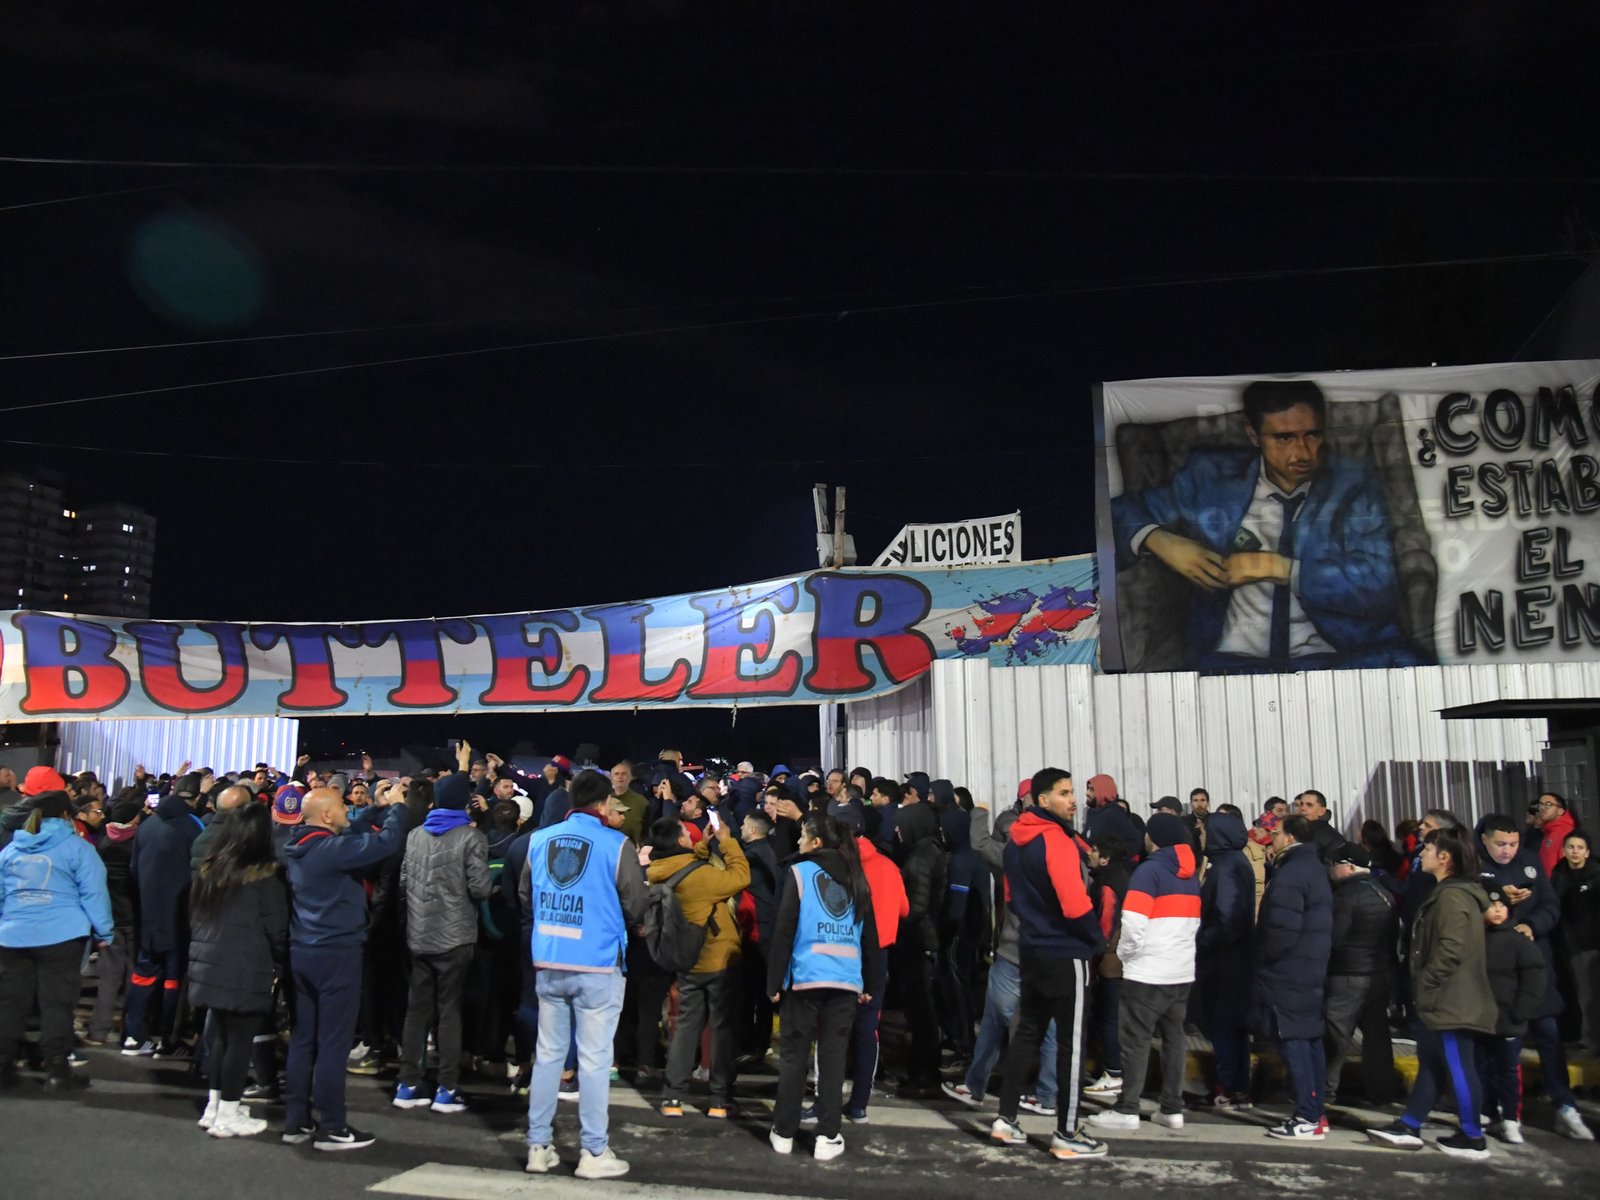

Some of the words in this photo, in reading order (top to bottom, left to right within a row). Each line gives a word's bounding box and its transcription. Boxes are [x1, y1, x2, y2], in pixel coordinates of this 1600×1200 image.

[1418, 380, 1600, 468] ¿COM
[1518, 526, 1585, 580] EL
[11, 571, 937, 716] BUTTELER
[540, 891, 584, 914] POLICIA
[817, 921, 854, 936] POLICIA
